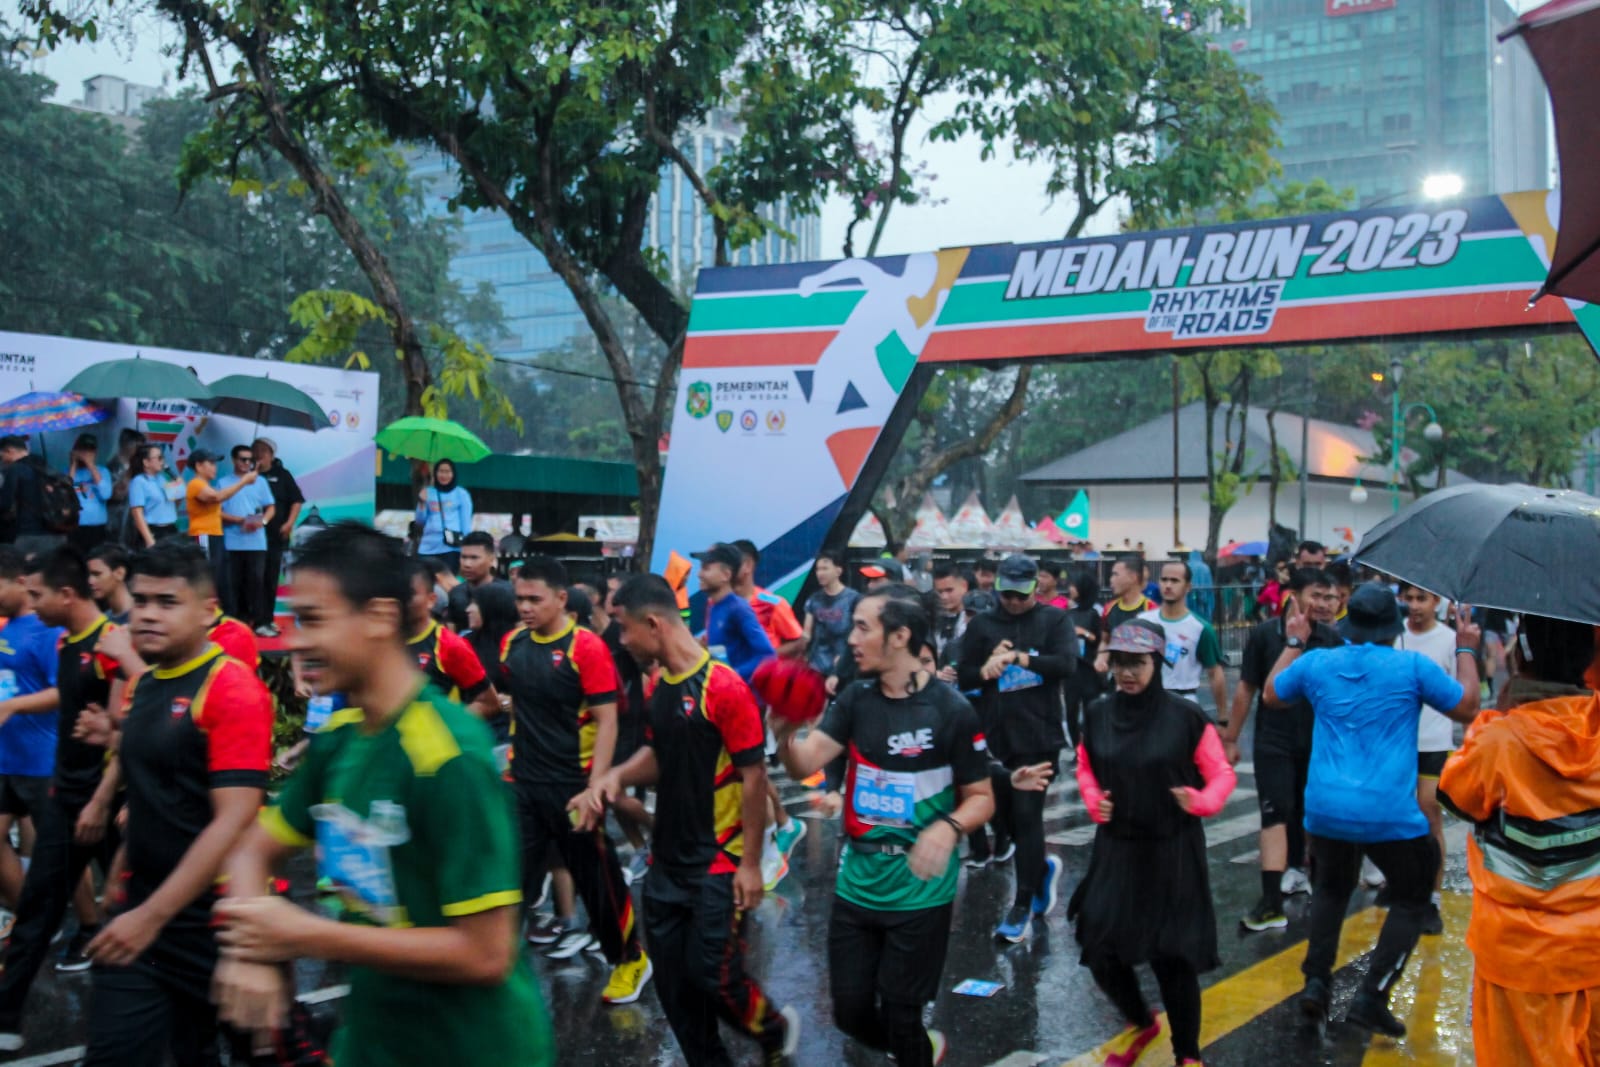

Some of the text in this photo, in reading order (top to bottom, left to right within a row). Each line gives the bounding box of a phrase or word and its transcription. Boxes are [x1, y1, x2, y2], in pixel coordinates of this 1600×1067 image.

[1003, 208, 1469, 301] MEDAN RUN 2023
[1151, 284, 1281, 313] RHYTHMS
[1150, 308, 1273, 335] OF THE ROADS
[716, 381, 789, 393] PEMERINTAH
[887, 727, 935, 755] SAVE
[857, 789, 906, 814] 0858
